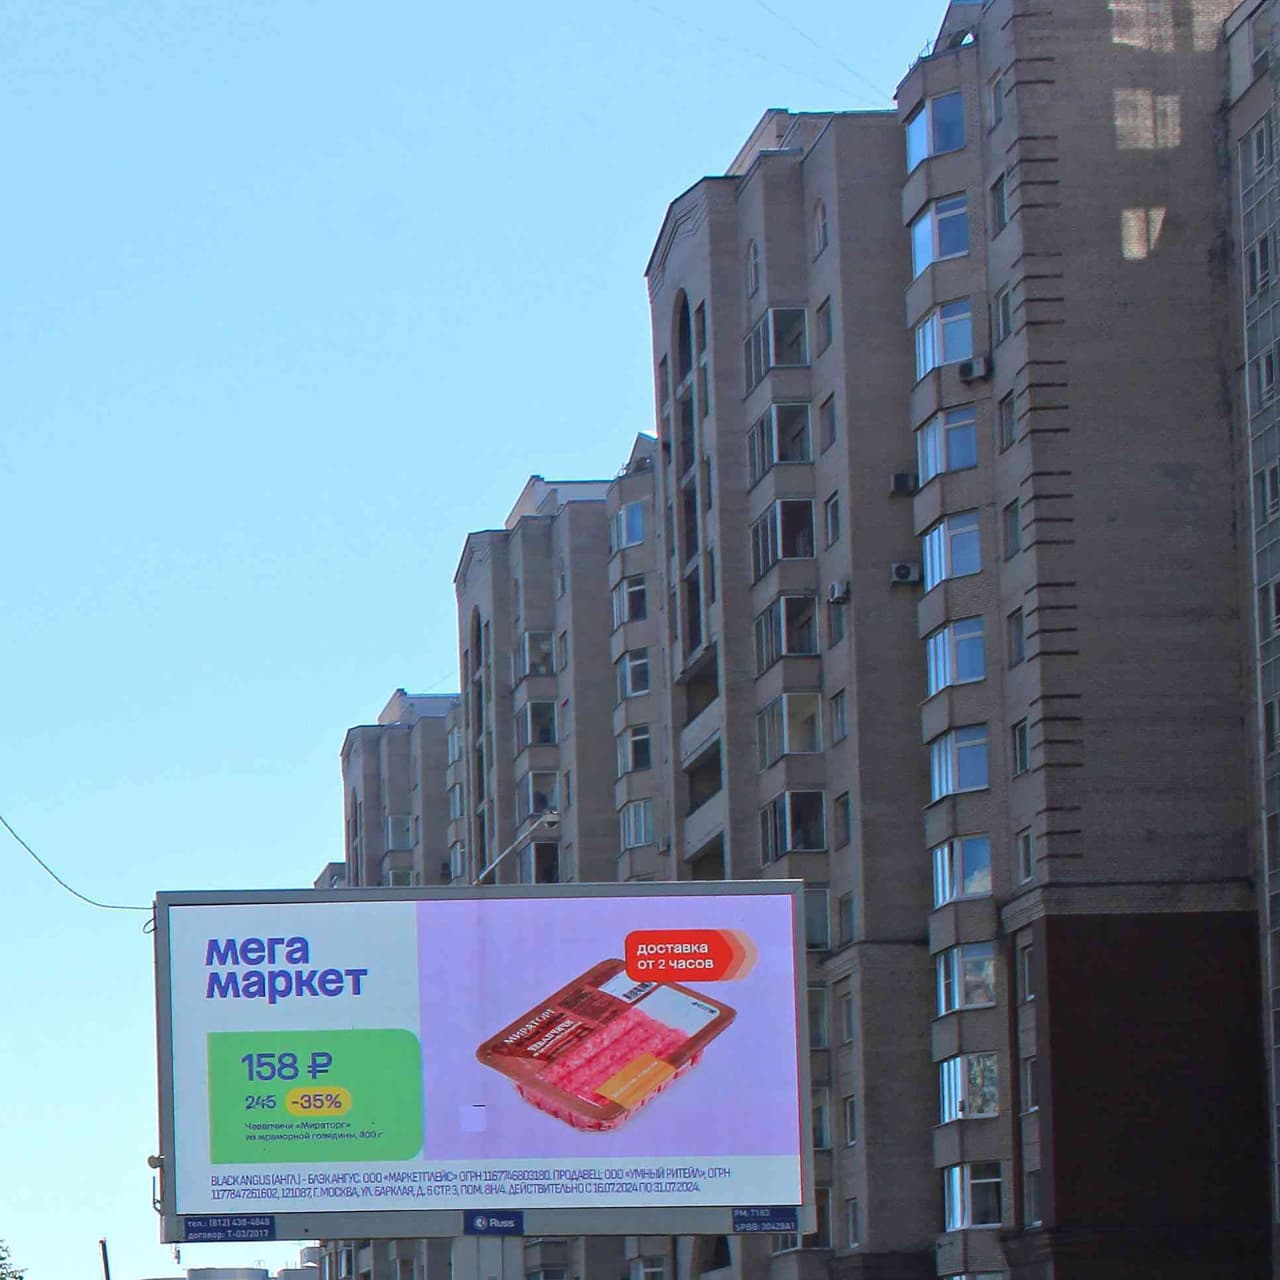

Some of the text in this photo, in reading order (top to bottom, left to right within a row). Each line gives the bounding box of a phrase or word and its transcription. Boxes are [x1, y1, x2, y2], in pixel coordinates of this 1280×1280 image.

[205, 937, 309, 966] мега
[637, 943, 708, 956] доставка
[637, 958, 714, 970] от 2 часов
[206, 968, 368, 1004] маркет
[241, 1053, 299, 1081] 158
[245, 1093, 343, 1110] 245 -35%
[211, 1175, 239, 1187] BLACK
[240, 1174, 272, 1186] ANGUS
[362, 1171, 382, 1183] ООО
[459, 1170, 482, 1182] ОГРН
[604, 1168, 624, 1180] ООО
[625, 1166, 664, 1179] «УМНЫЙ
[707, 1167, 731, 1178] ОГРН
[460, 1183, 483, 1195] ПОМ.
[508, 1181, 584, 1195] ДЕЙСТВИТЕЛЬНО
[489, 1218, 515, 1228] Russ
